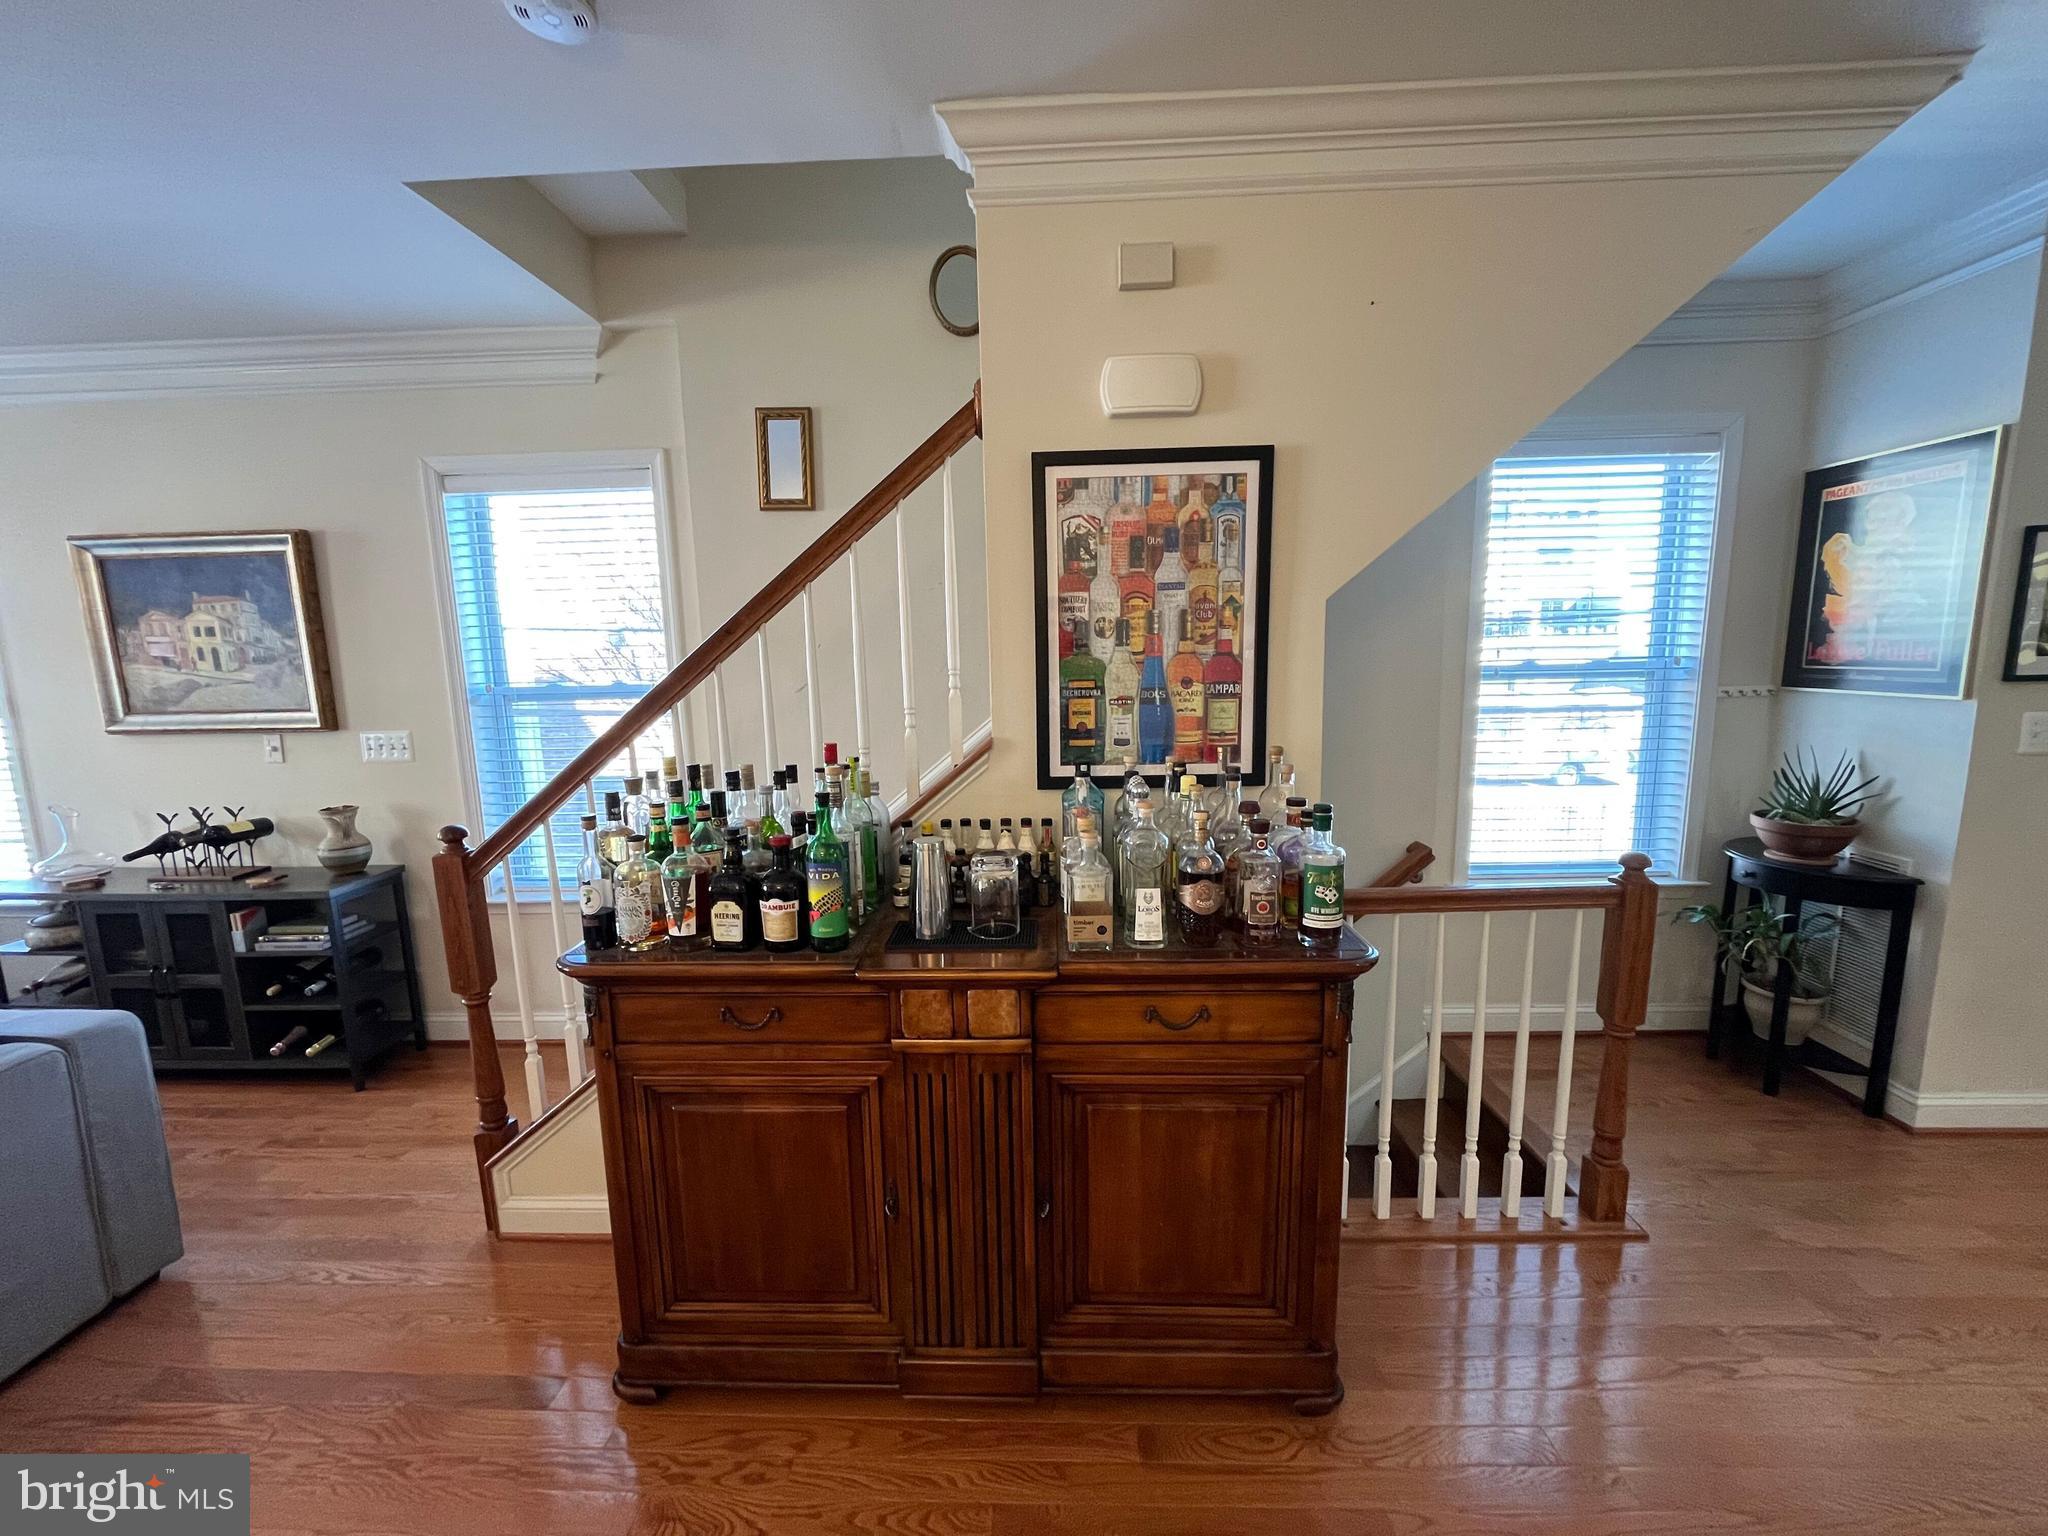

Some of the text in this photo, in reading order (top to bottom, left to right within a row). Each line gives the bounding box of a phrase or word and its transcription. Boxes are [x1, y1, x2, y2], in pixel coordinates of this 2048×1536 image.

[1195, 610, 1213, 618] Club
[1141, 690, 1166, 698] BOLS
[808, 871, 840, 880] VIDA
[1073, 918, 1094, 926] timber
